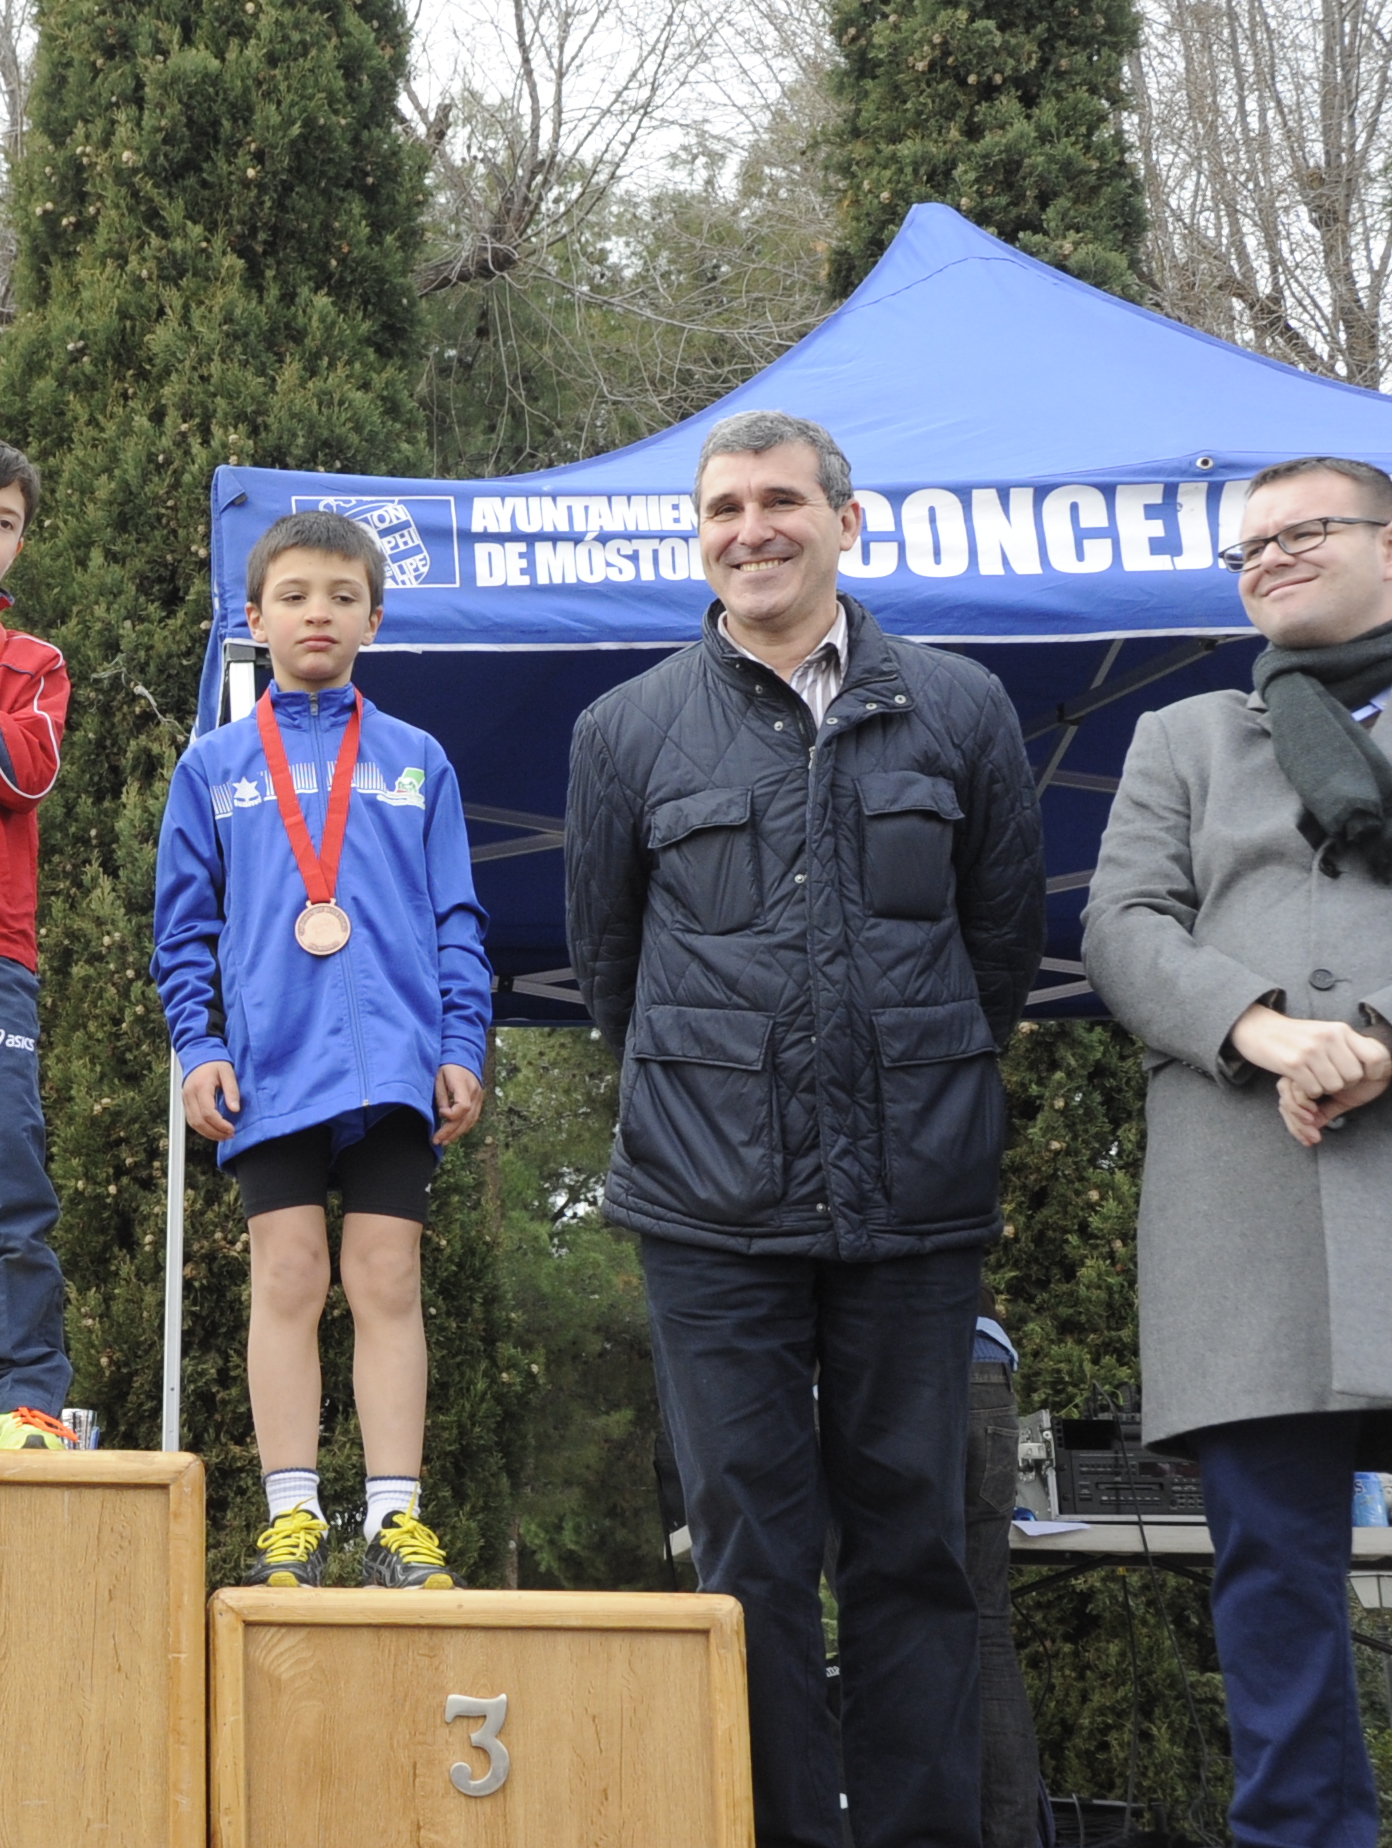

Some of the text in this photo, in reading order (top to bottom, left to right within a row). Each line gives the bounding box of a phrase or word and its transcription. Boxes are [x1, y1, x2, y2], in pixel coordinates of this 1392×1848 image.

[471, 494, 698, 533] AYUNTAMIEN
[474, 532, 707, 587] DE MÓSTOL
[444, 1693, 511, 1797] 3
